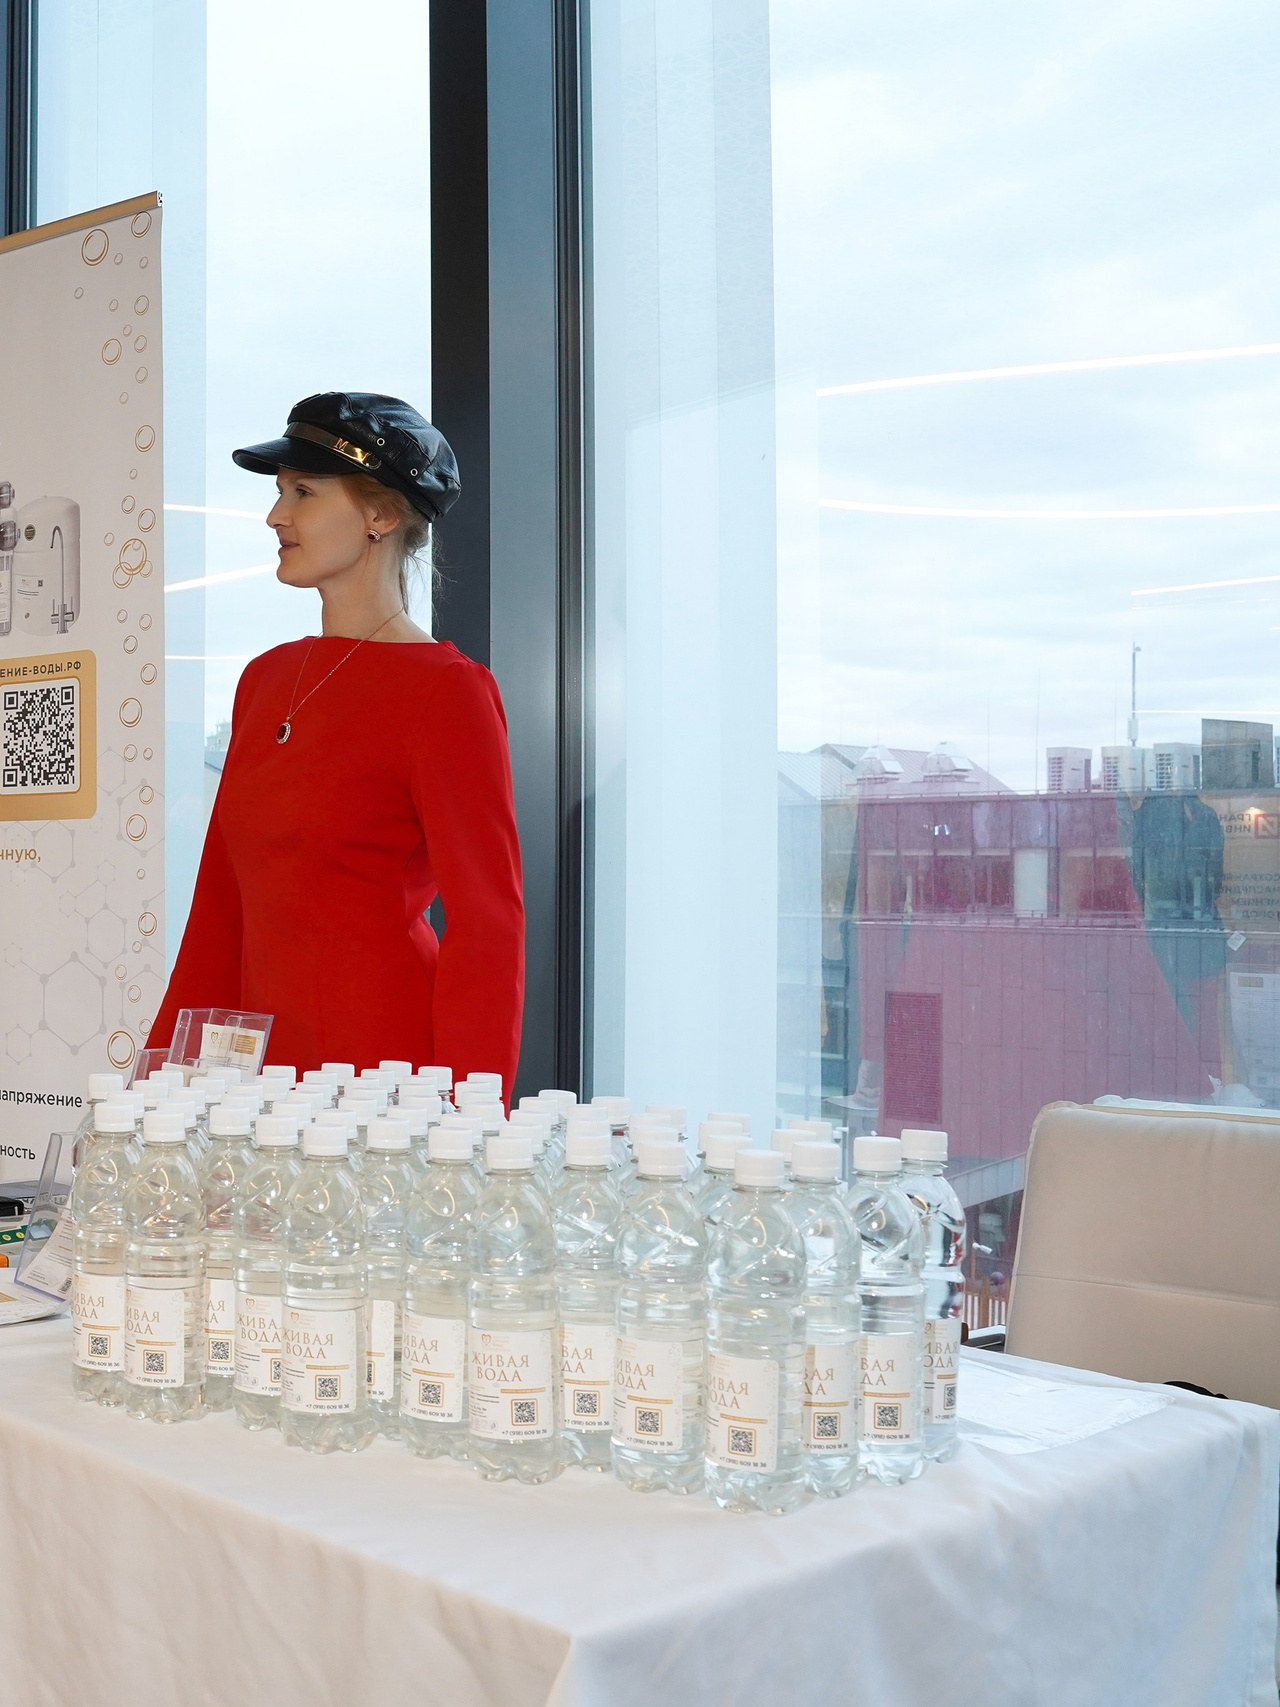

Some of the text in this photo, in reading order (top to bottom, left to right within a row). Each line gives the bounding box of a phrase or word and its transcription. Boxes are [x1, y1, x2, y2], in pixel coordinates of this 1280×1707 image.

[75, 1292, 105, 1307] ИВАЯ
[75, 1304, 98, 1319] ОДА
[126, 1307, 160, 1323] ИВАЯ
[125, 1320, 153, 1335] ОДА
[237, 1313, 281, 1329] ЖИВА
[283, 1327, 334, 1346] ЖИВАЯ
[404, 1333, 438, 1352] ИВАЯ
[286, 1342, 326, 1359] ВОДА
[404, 1347, 430, 1364] ОДА
[472, 1351, 529, 1368] ЖИВАЯ
[616, 1358, 654, 1378] ИВАЯ
[477, 1367, 522, 1382] ВОДА
[615, 1373, 647, 1391] ОДА
[708, 1374, 749, 1395] ИВАЯ
[708, 1390, 741, 1410] ОДА
